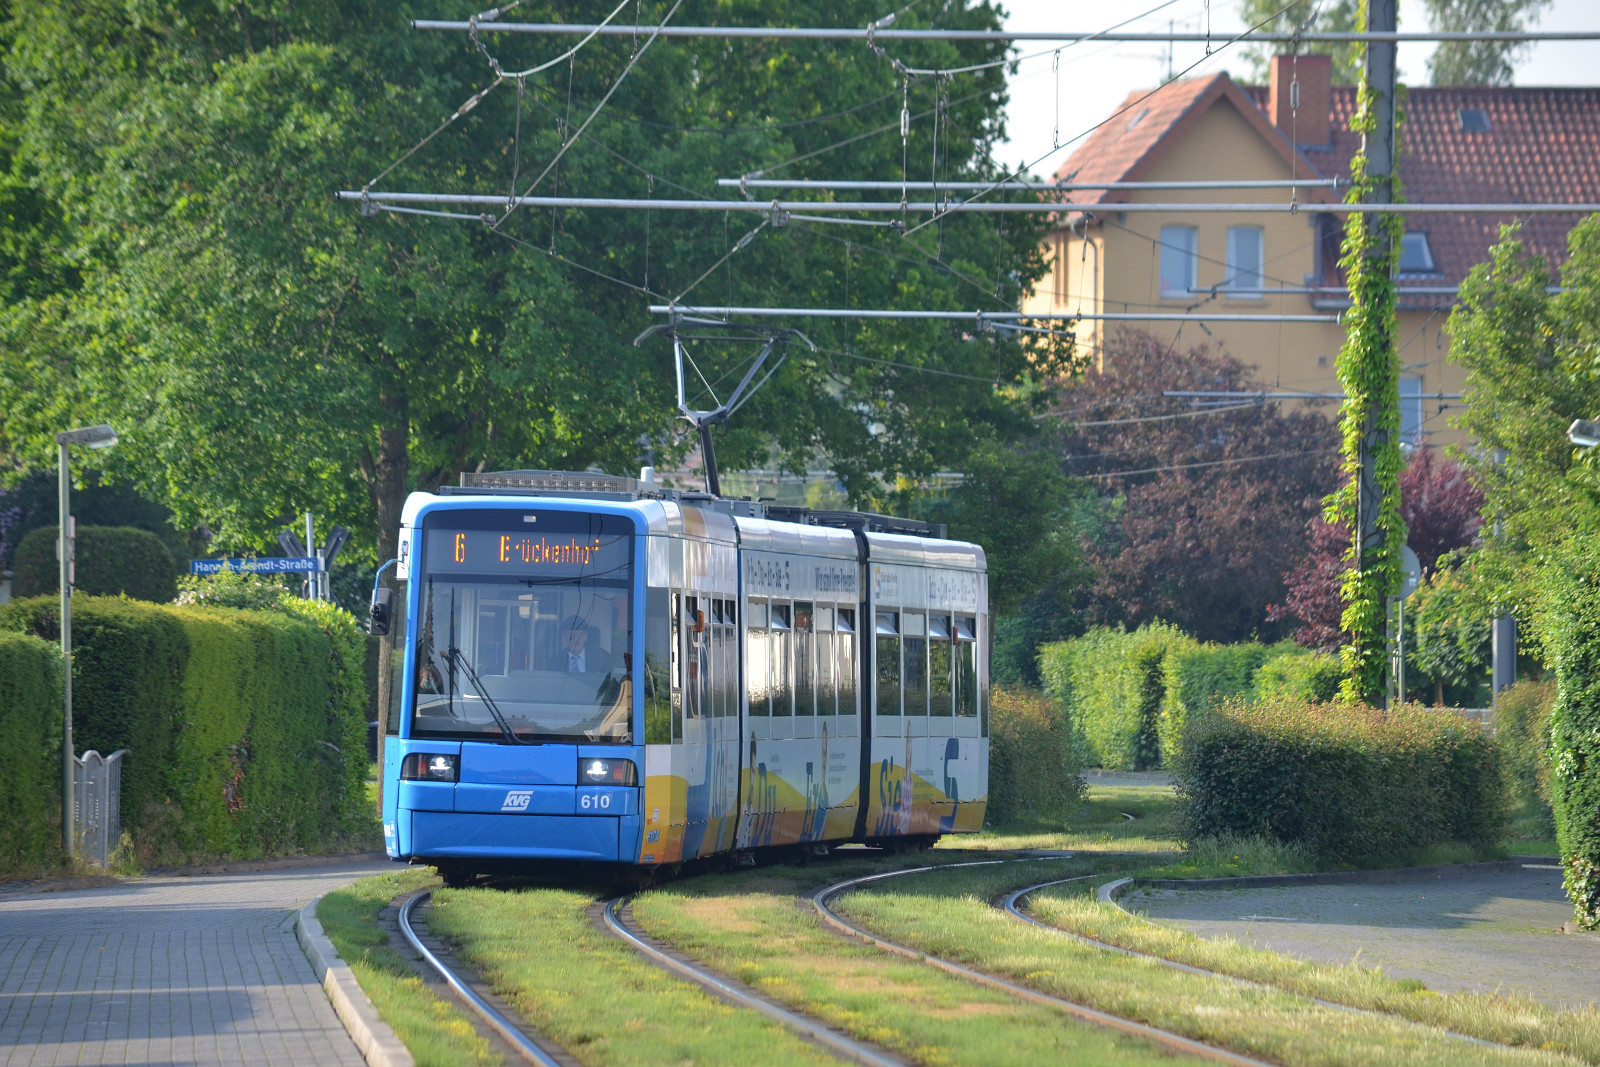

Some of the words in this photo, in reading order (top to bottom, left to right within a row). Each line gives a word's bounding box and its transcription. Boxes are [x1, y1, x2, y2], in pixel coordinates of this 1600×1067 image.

[455, 533, 466, 563] 6
[194, 559, 314, 572] Hannh-Aendt-Straße
[502, 794, 532, 808] KVG
[581, 795, 610, 809] 610
[875, 755, 903, 836] Sie
